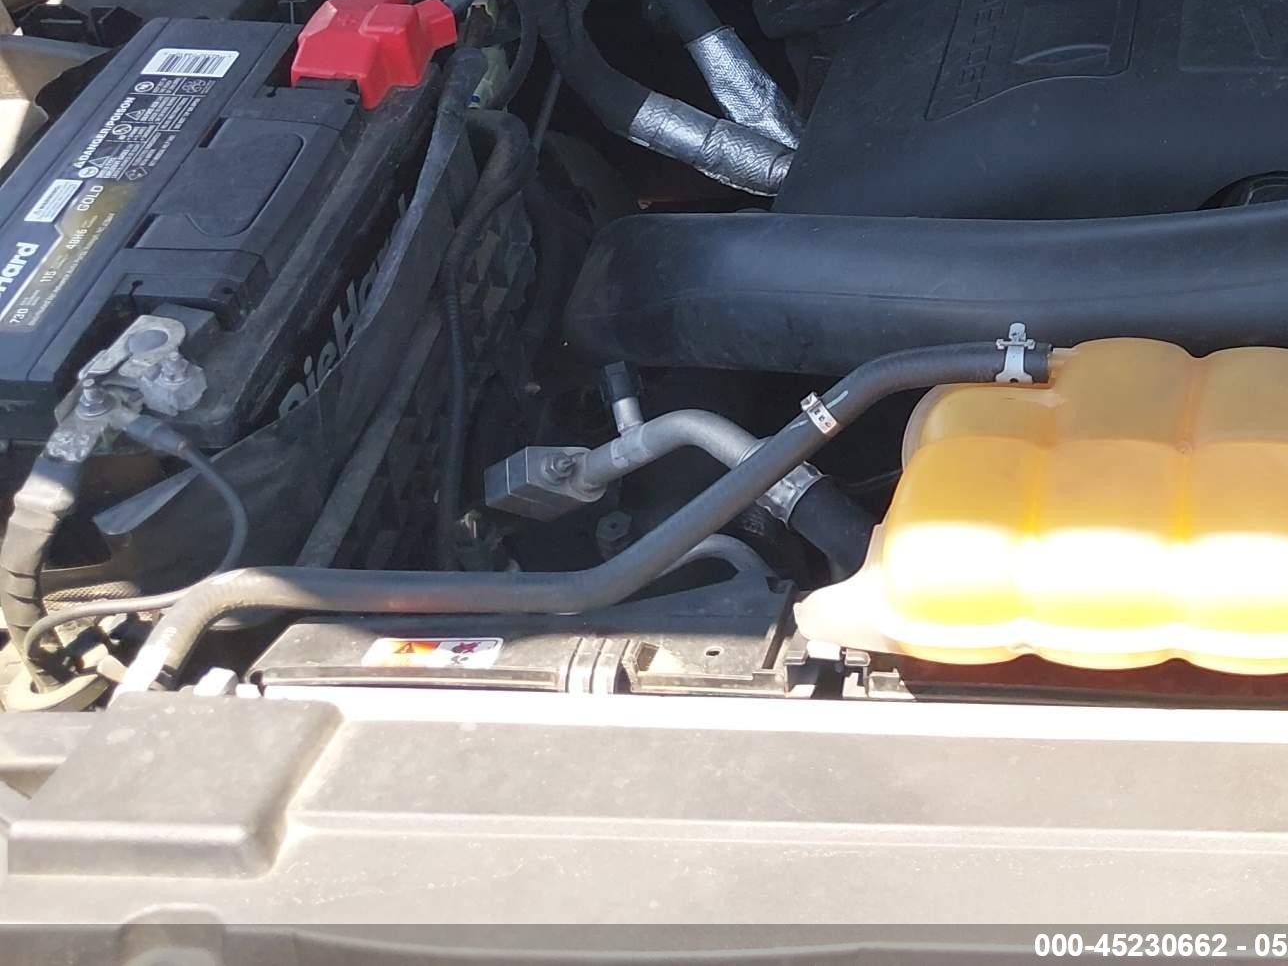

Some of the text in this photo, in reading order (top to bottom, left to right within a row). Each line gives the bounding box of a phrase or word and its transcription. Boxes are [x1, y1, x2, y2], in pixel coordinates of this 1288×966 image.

[77, 185, 104, 212] GOLD
[0, 241, 40, 296] Hard
[9, 308, 29, 323] 730
